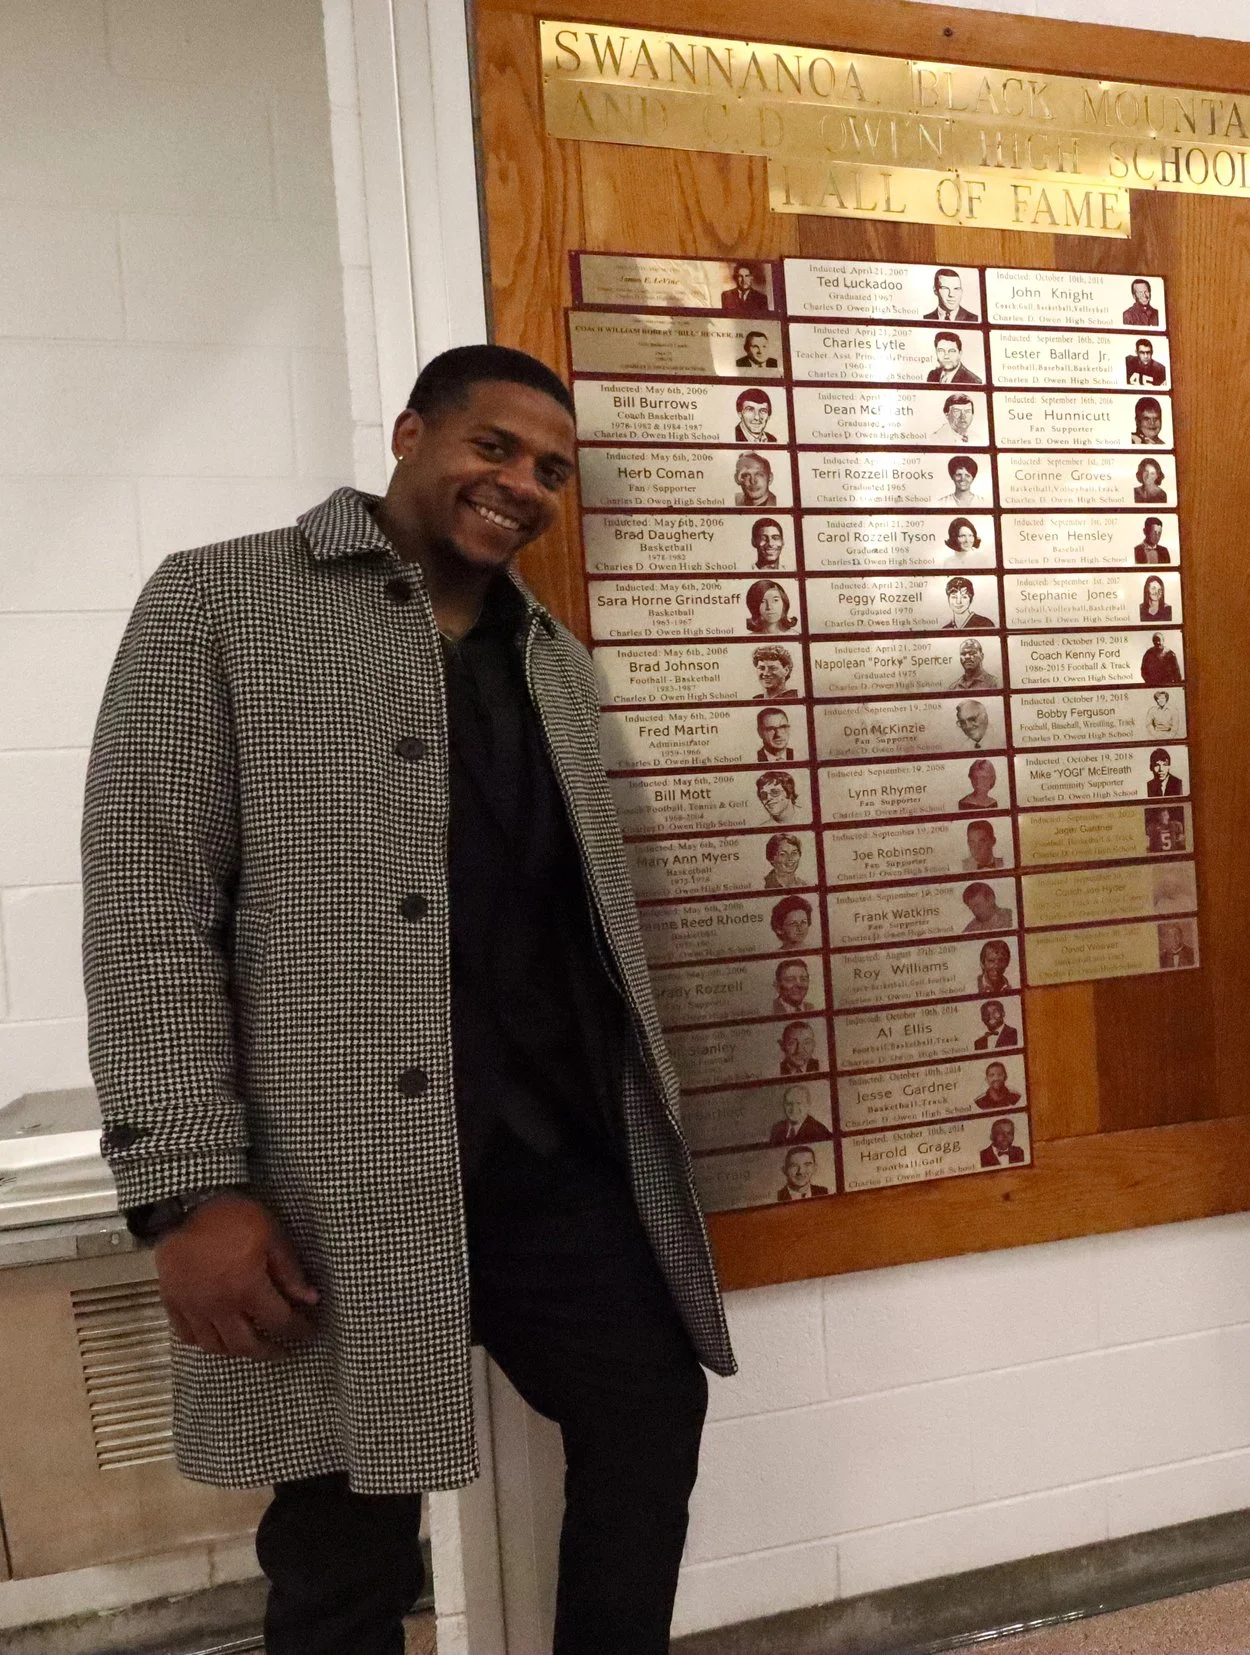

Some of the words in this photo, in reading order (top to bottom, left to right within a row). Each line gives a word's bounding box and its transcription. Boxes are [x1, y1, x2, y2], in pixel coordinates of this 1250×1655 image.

[916, 68, 1055, 122] BLACK
[569, 87, 669, 137] AND
[980, 130, 1083, 175] HIGH
[936, 176, 986, 222] OF
[1010, 184, 1126, 232] FAME
[817, 276, 839, 287] Ted
[843, 277, 903, 291] Luckadoo
[1012, 286, 1041, 299] John
[1051, 288, 1094, 302] Knight
[642, 328, 672, 336] ROBERT
[823, 338, 872, 349] Charles
[876, 339, 906, 352] Lytle
[1004, 348, 1041, 359] Lester
[1050, 349, 1089, 360] Ballard
[1099, 351, 1111, 362] Jr.
[600, 384, 642, 393] Inducted:
[645, 386, 664, 396] May
[667, 386, 684, 395] 6th,
[687, 387, 708, 395] 2006
[613, 397, 635, 408] Bill
[640, 397, 698, 410] Burrows
[824, 404, 856, 415] Dean
[617, 412, 645, 420] Coach
[648, 412, 694, 421] Basketball
[1008, 409, 1033, 421] Sue
[1044, 410, 1111, 422] Hunnicutt
[594, 430, 626, 438] Charles
[642, 431, 666, 440] Owen
[668, 432, 690, 441] High
[692, 433, 720, 441] School
[606, 452, 647, 462] Inducted:
[651, 453, 670, 463] May
[672, 453, 690, 462] 6th,
[692, 454, 713, 462] 2006
[618, 467, 652, 479] Herb
[656, 468, 704, 480] Coman
[812, 468, 841, 479] Terri
[845, 469, 888, 480] Rozzell
[892, 469, 934, 480] Brooks
[1014, 470, 1063, 481] Corinne
[1070, 470, 1112, 481] Groves
[615, 530, 644, 540] Brad
[648, 530, 714, 542] Daugherty
[817, 532, 850, 543] Carol
[854, 532, 897, 542] Rozzell
[901, 532, 936, 544] Tyson
[1019, 531, 1059, 541] Steven
[1068, 530, 1114, 542] Hensley
[640, 544, 693, 552] Basketball
[596, 563, 633, 571] Charles
[649, 563, 677, 571] Owen
[679, 563, 702, 572] High
[705, 562, 737, 571] School
[597, 596, 628, 607] Sara
[632, 596, 672, 606] Horne
[675, 593, 741, 606] Grindstaff
[838, 593, 875, 606] Peggy
[879, 592, 922, 603] Rozzell
[1020, 590, 1078, 603] Stephanie
[1087, 589, 1118, 600] Jones
[1062, 638, 1093, 646] October
[1096, 637, 1108, 645] 19,
[1109, 636, 1128, 644] 2018
[1031, 651, 1062, 661] Coach
[1065, 649, 1095, 661] Kenny
[1099, 649, 1120, 658] Ford
[629, 661, 660, 672] Brad
[665, 660, 720, 672] Johnson
[815, 659, 866, 670] Napolean
[868, 656, 908, 668] "Porky"
[911, 655, 952, 666] Spencer
[1025, 663, 1065, 673] 1986-2015
[1068, 663, 1099, 672] Football
[1021, 676, 1051, 685] Charles
[1063, 675, 1086, 683] Owen
[1087, 674, 1106, 683] High
[1107, 673, 1134, 681] School
[1037, 709, 1067, 720] Bobby
[1071, 707, 1115, 718] Ferguson
[639, 726, 670, 737] Fred
[674, 724, 719, 736] Martin
[844, 726, 868, 737] Don
[872, 723, 926, 735] McKinzie
[1020, 722, 1050, 732] Football,
[1051, 721, 1081, 730] Baseball,
[1118, 718, 1136, 726] Track
[649, 739, 710, 749] Administrator
[1030, 769, 1052, 779] Mike
[1088, 765, 1132, 776] McElreath
[1041, 780, 1085, 791] Community
[1088, 779, 1124, 790] Supporter
[655, 790, 676, 801] Bill
[680, 789, 711, 800] Mott
[848, 787, 877, 799] Lynn
[881, 785, 927, 797] Rhymer
[1080, 824, 1113, 833] Gardner
[1161, 832, 1172, 851] 5
[672, 853, 698, 864] Ann
[701, 851, 740, 862] Myers
[852, 850, 874, 861] Joe
[877, 846, 933, 858] Robinson
[681, 915, 713, 928] Reed
[716, 913, 764, 925] Rhodes
[854, 911, 888, 923] Frank
[892, 907, 940, 920] Watkins
[853, 968, 881, 980] Roy
[891, 961, 949, 975] Williams
[695, 981, 743, 995] Rozzell
[877, 1027, 893, 1039] Al
[904, 1023, 933, 1036] Ellis
[856, 1090, 893, 1104] Jesse
[903, 1082, 957, 1096] Gardner
[860, 1146, 907, 1162] Harold
[917, 1140, 961, 1154] Gragg
